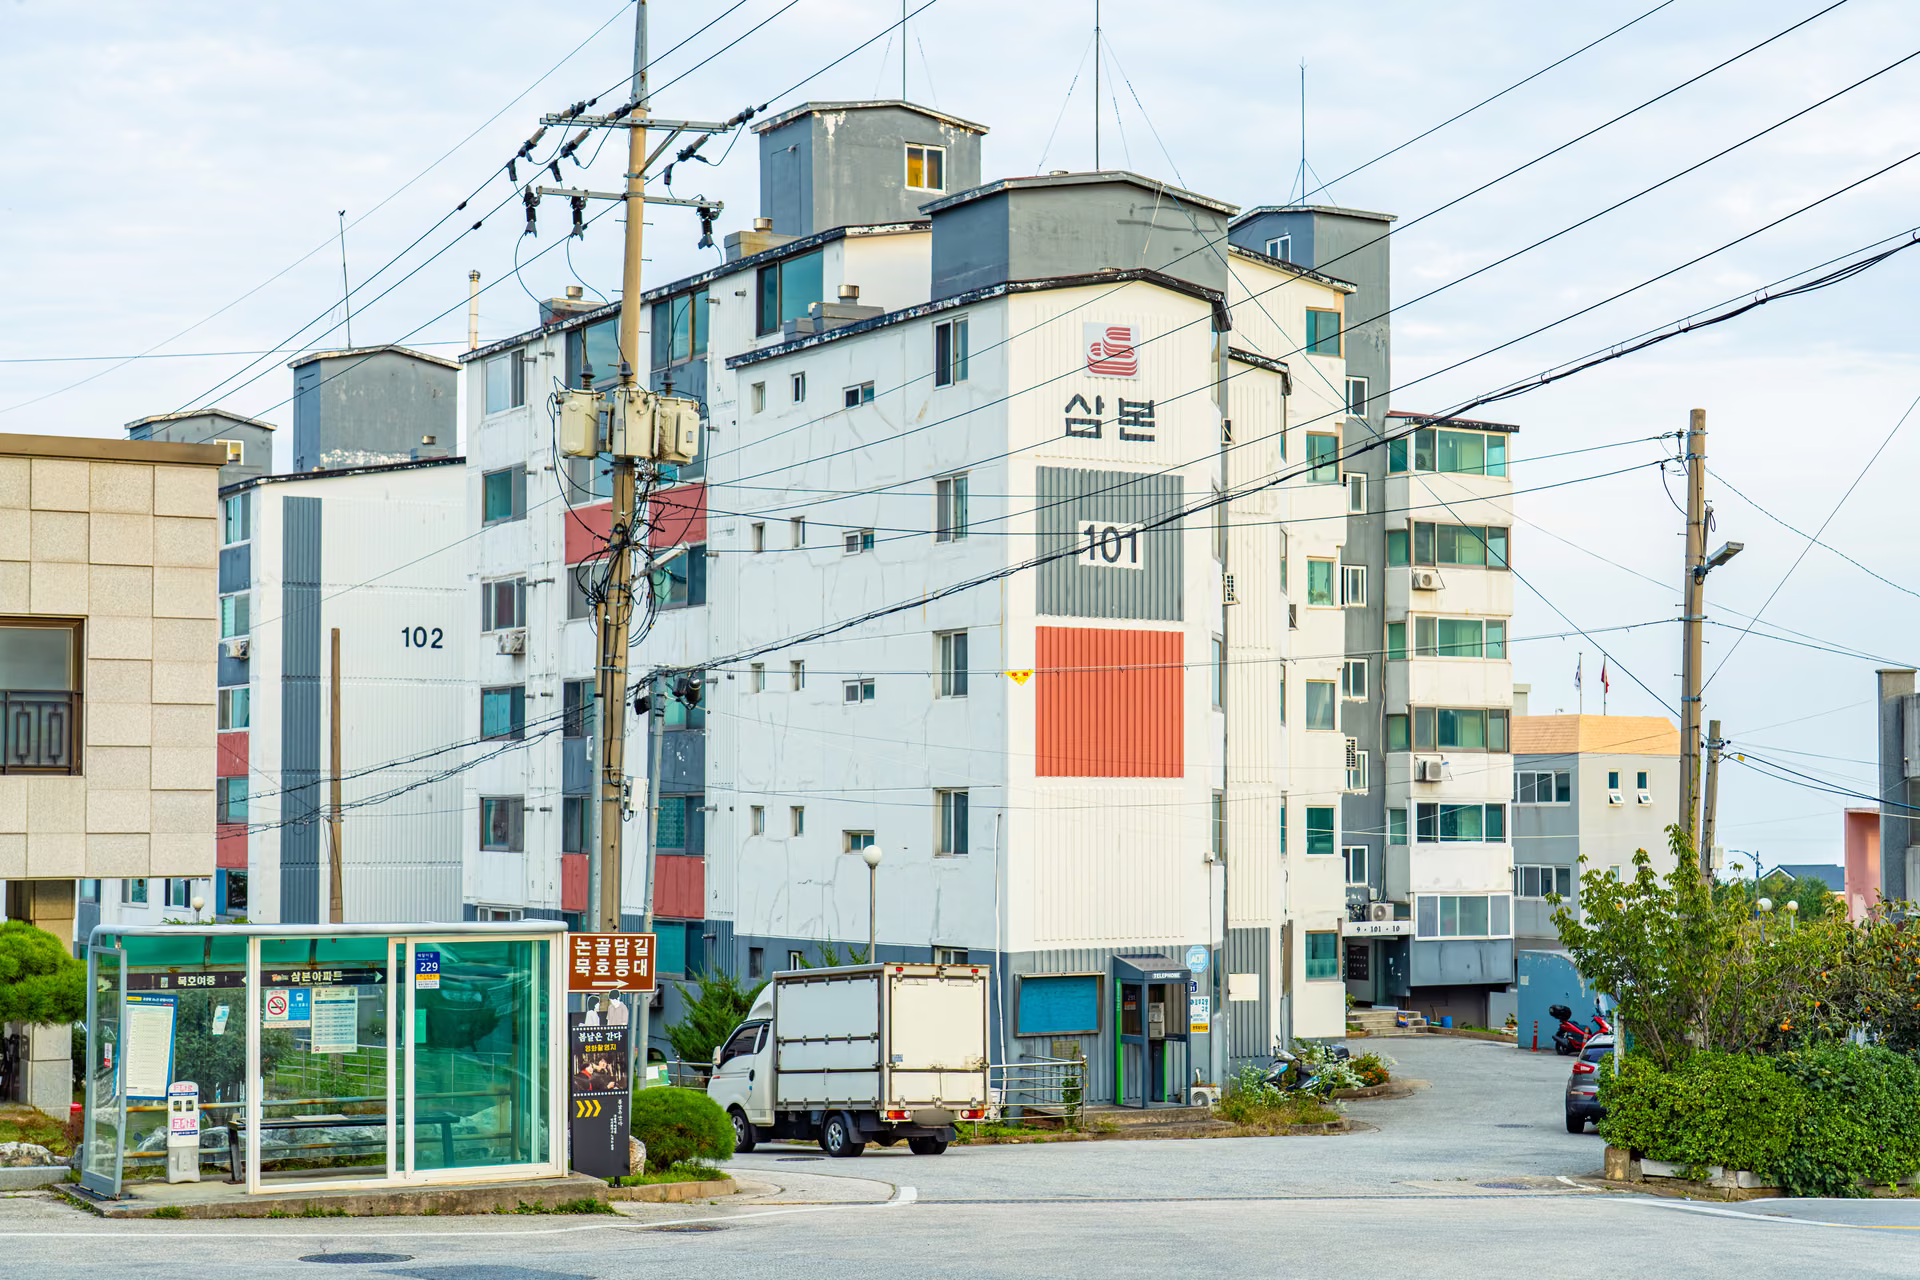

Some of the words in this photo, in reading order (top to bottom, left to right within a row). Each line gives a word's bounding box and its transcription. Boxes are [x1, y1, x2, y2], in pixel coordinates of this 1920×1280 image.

[1065, 393, 1155, 442] 삼본
[1084, 524, 1137, 564] 101
[401, 626, 443, 648] 102
[574, 938, 648, 956] 논골담길
[420, 962, 438, 972] 229
[575, 958, 648, 976] 묵호등대
[290, 971, 343, 982] 삼본아파트
[578, 1031, 603, 1042] 봄날은
[605, 1031, 622, 1041] 간다
